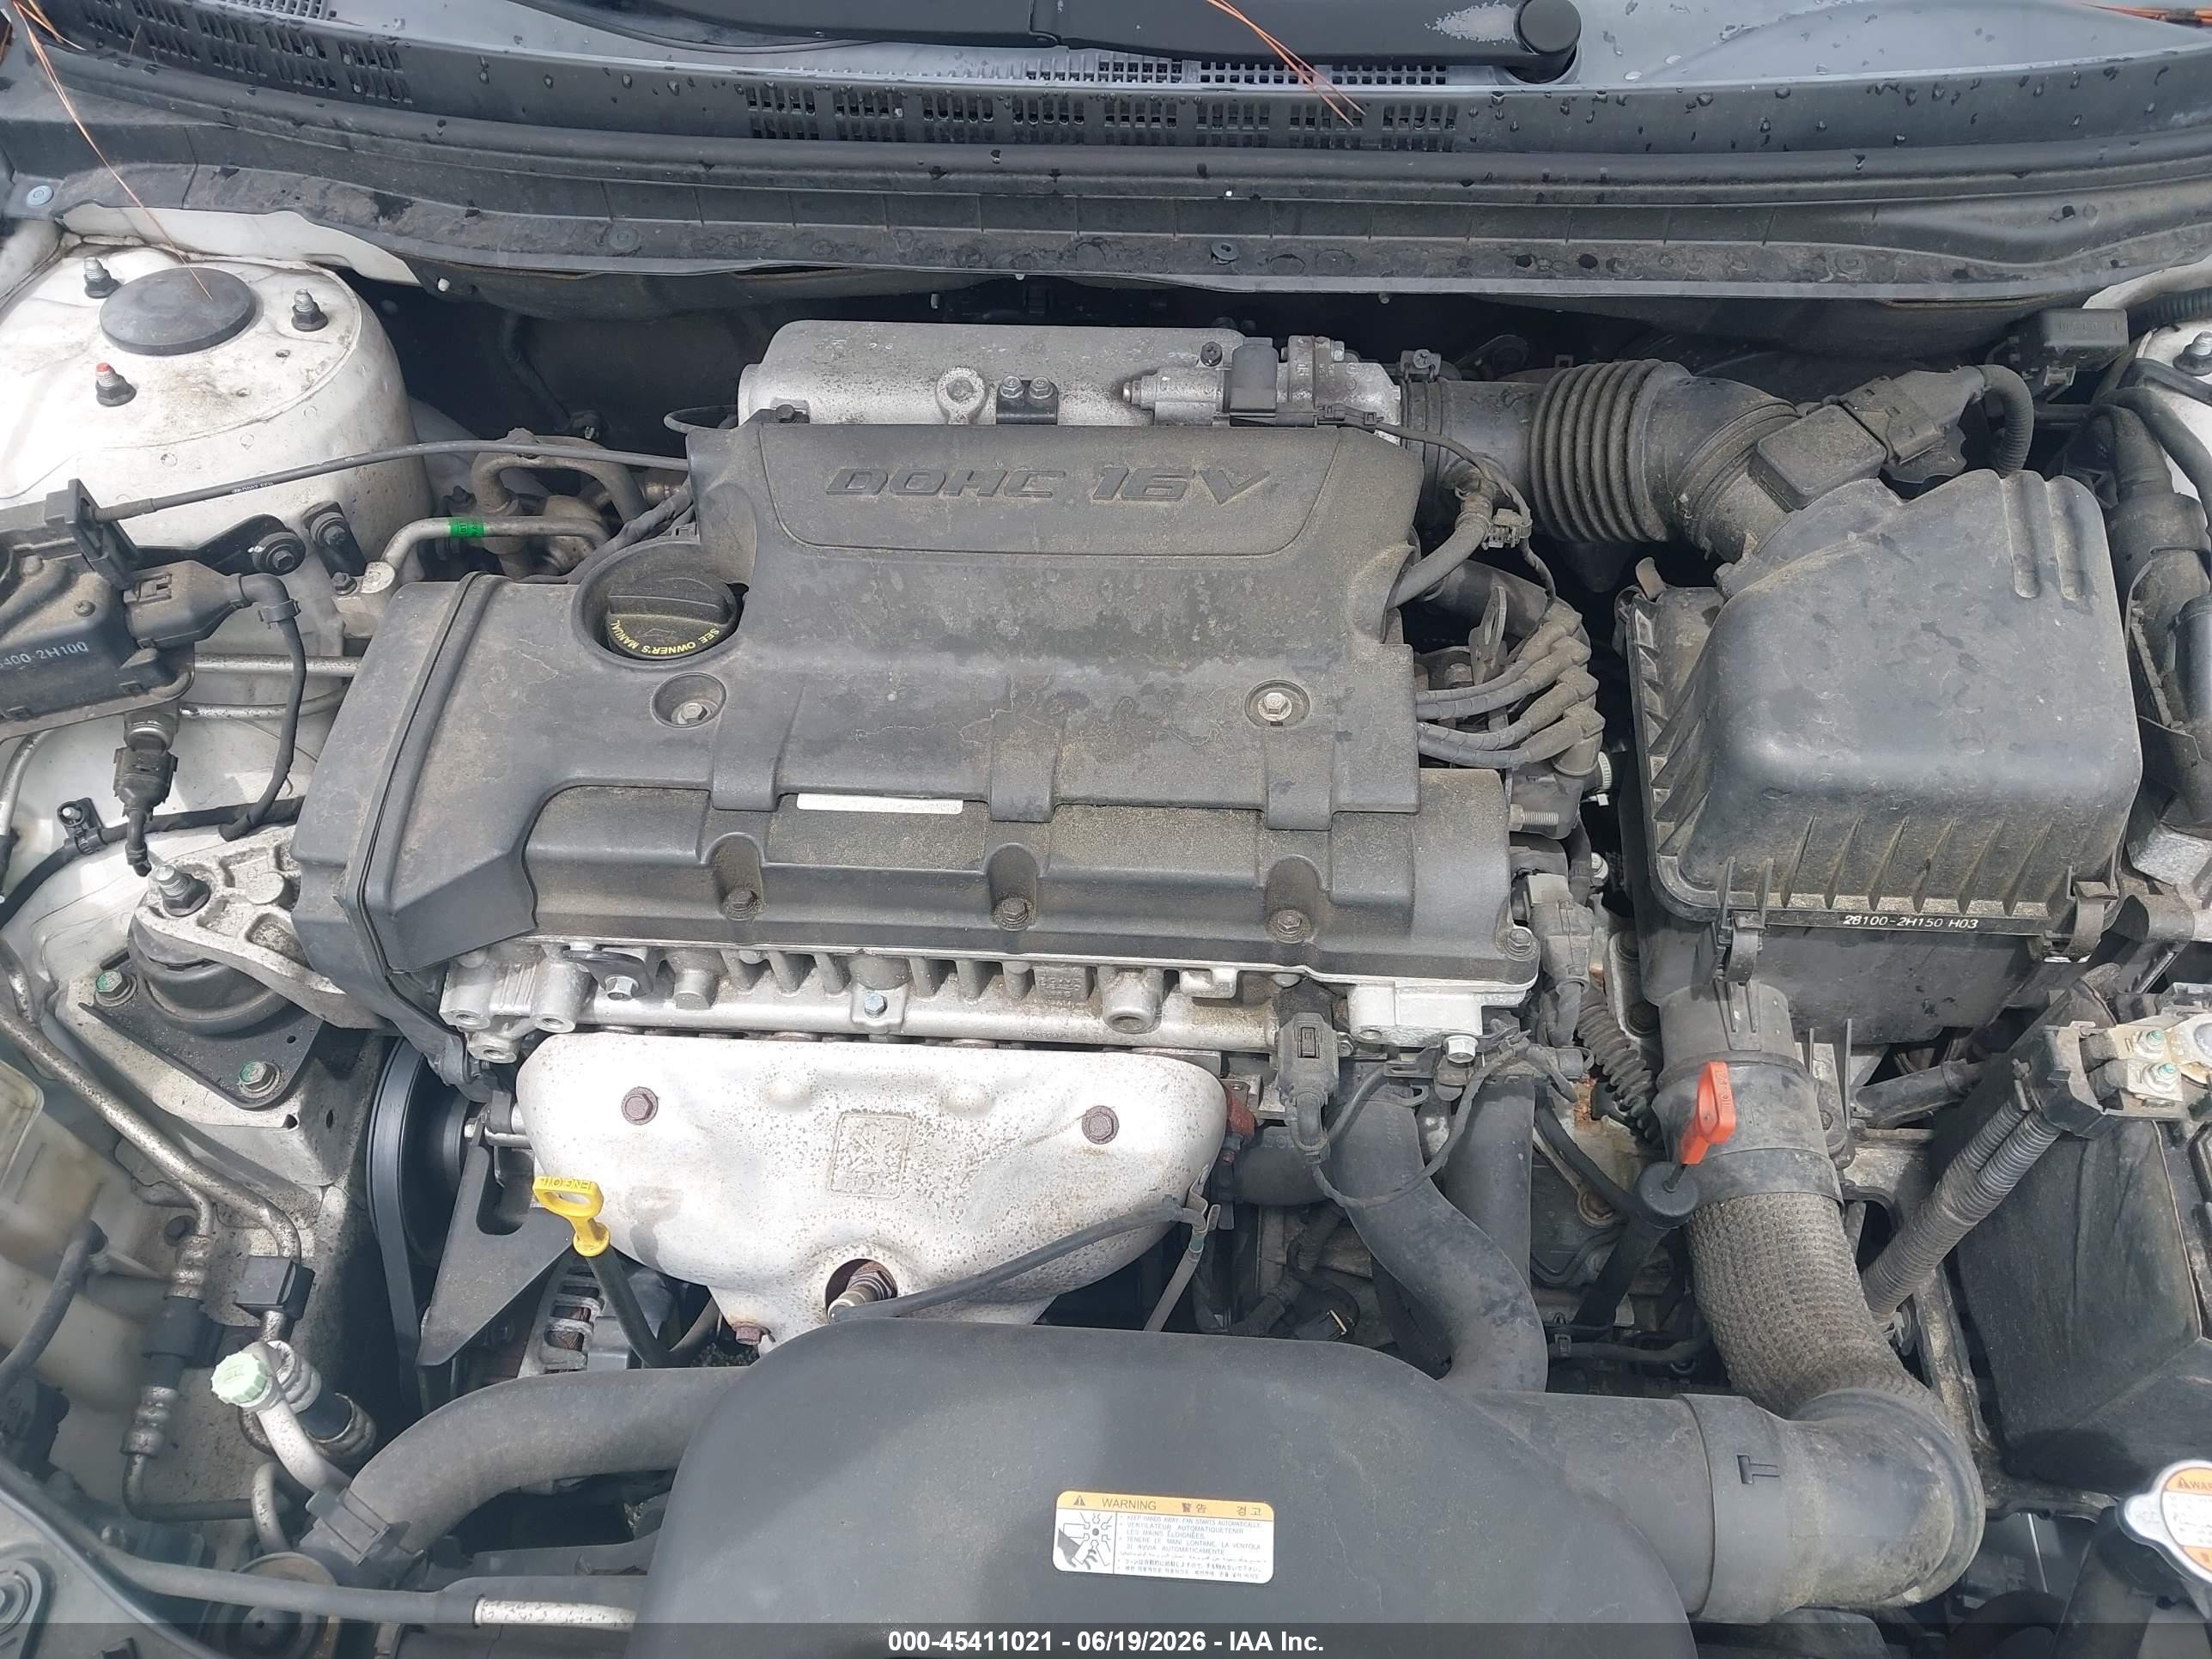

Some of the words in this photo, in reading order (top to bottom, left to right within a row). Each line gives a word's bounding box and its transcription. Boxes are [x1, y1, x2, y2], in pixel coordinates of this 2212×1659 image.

[826, 467, 1066, 499] DOHC
[1091, 467, 1271, 507] 16V
[610, 619, 640, 650] MANUAL
[698, 627, 720, 644] SEE
[641, 641, 696, 655] OWNER'S
[1843, 915, 1943, 928] 28100-2H150
[1948, 918, 1979, 929] H03
[539, 1176, 563, 1188] OIL
[565, 1177, 592, 1191] ENG
[1102, 1497, 1158, 1511] WARNING
